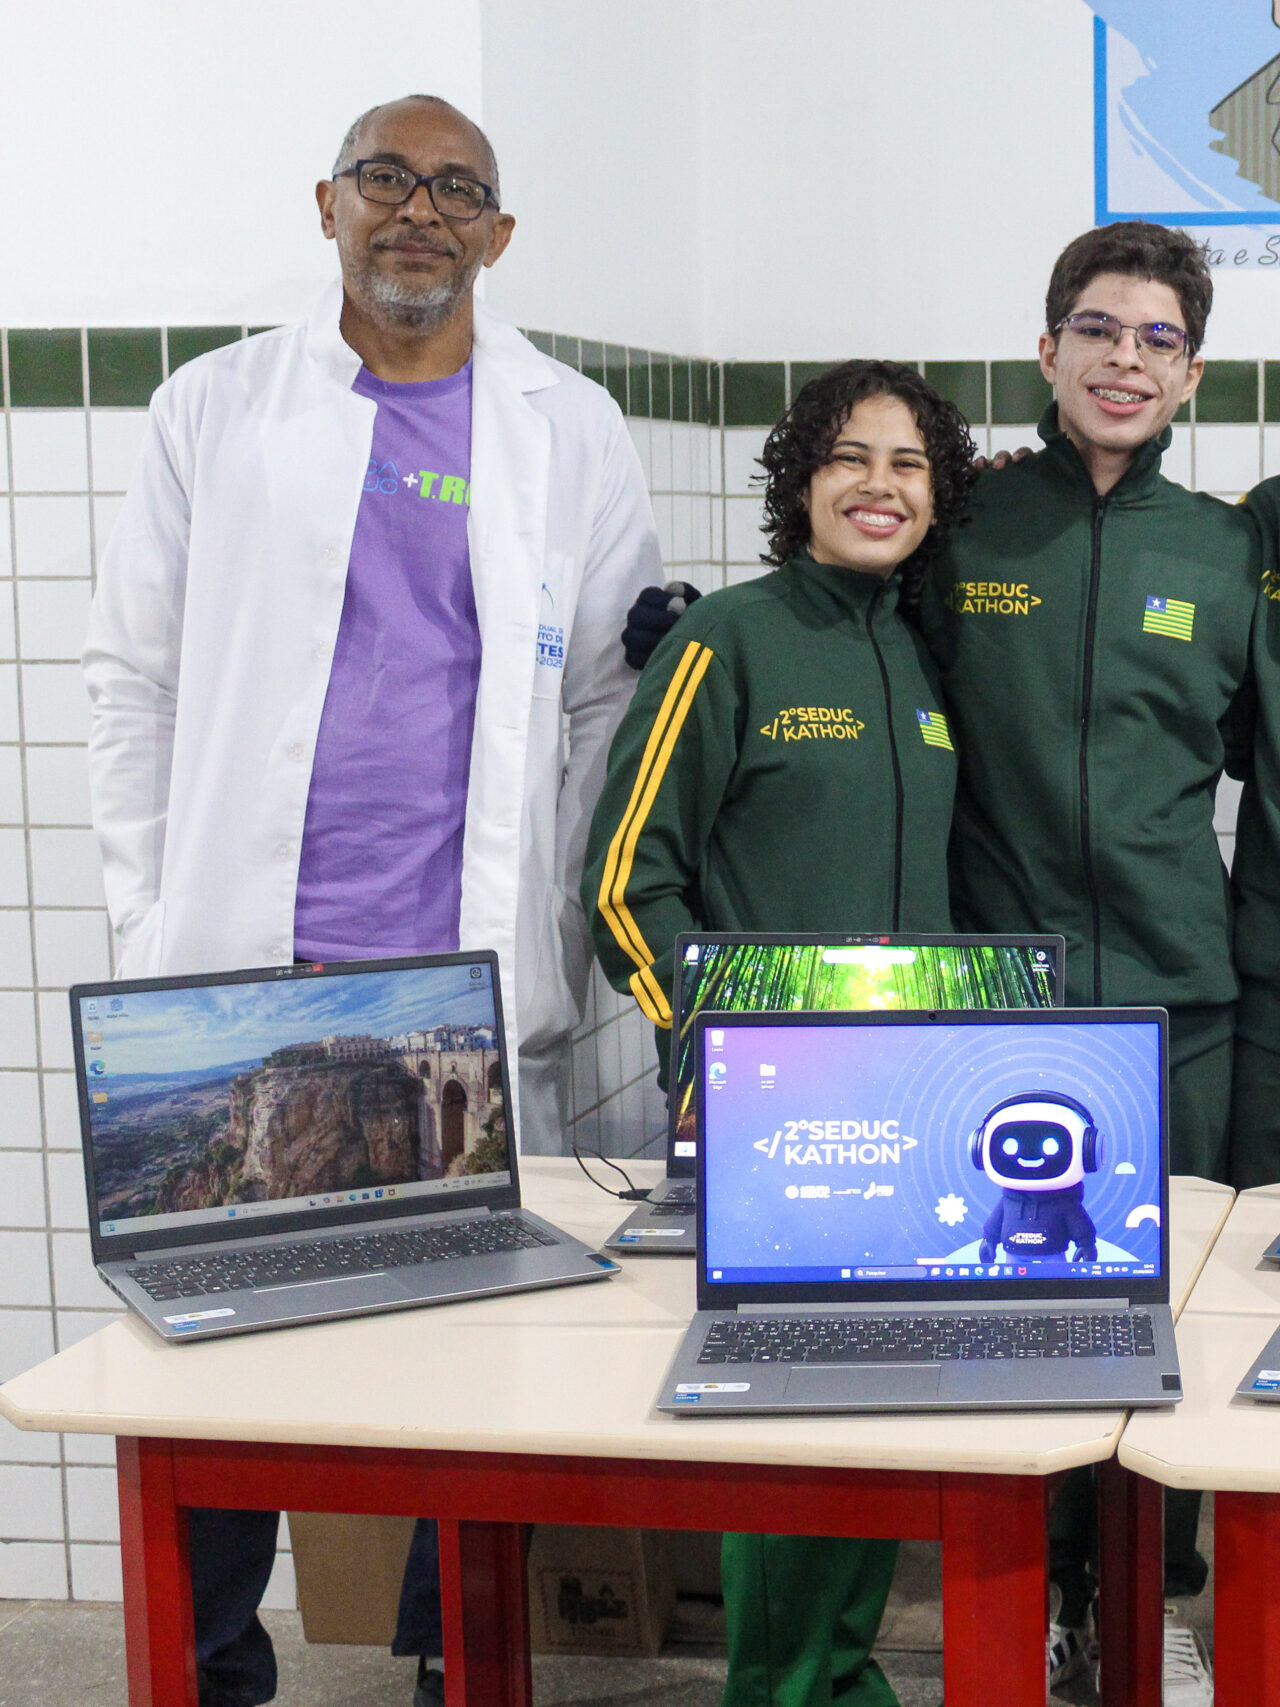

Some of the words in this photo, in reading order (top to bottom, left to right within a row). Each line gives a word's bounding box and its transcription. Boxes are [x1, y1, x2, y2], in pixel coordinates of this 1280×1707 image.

[1233, 248, 1249, 266] e
[958, 599, 1029, 615] ATHON
[782, 723, 859, 743] KATHON
[784, 1143, 900, 1165] KATHON
